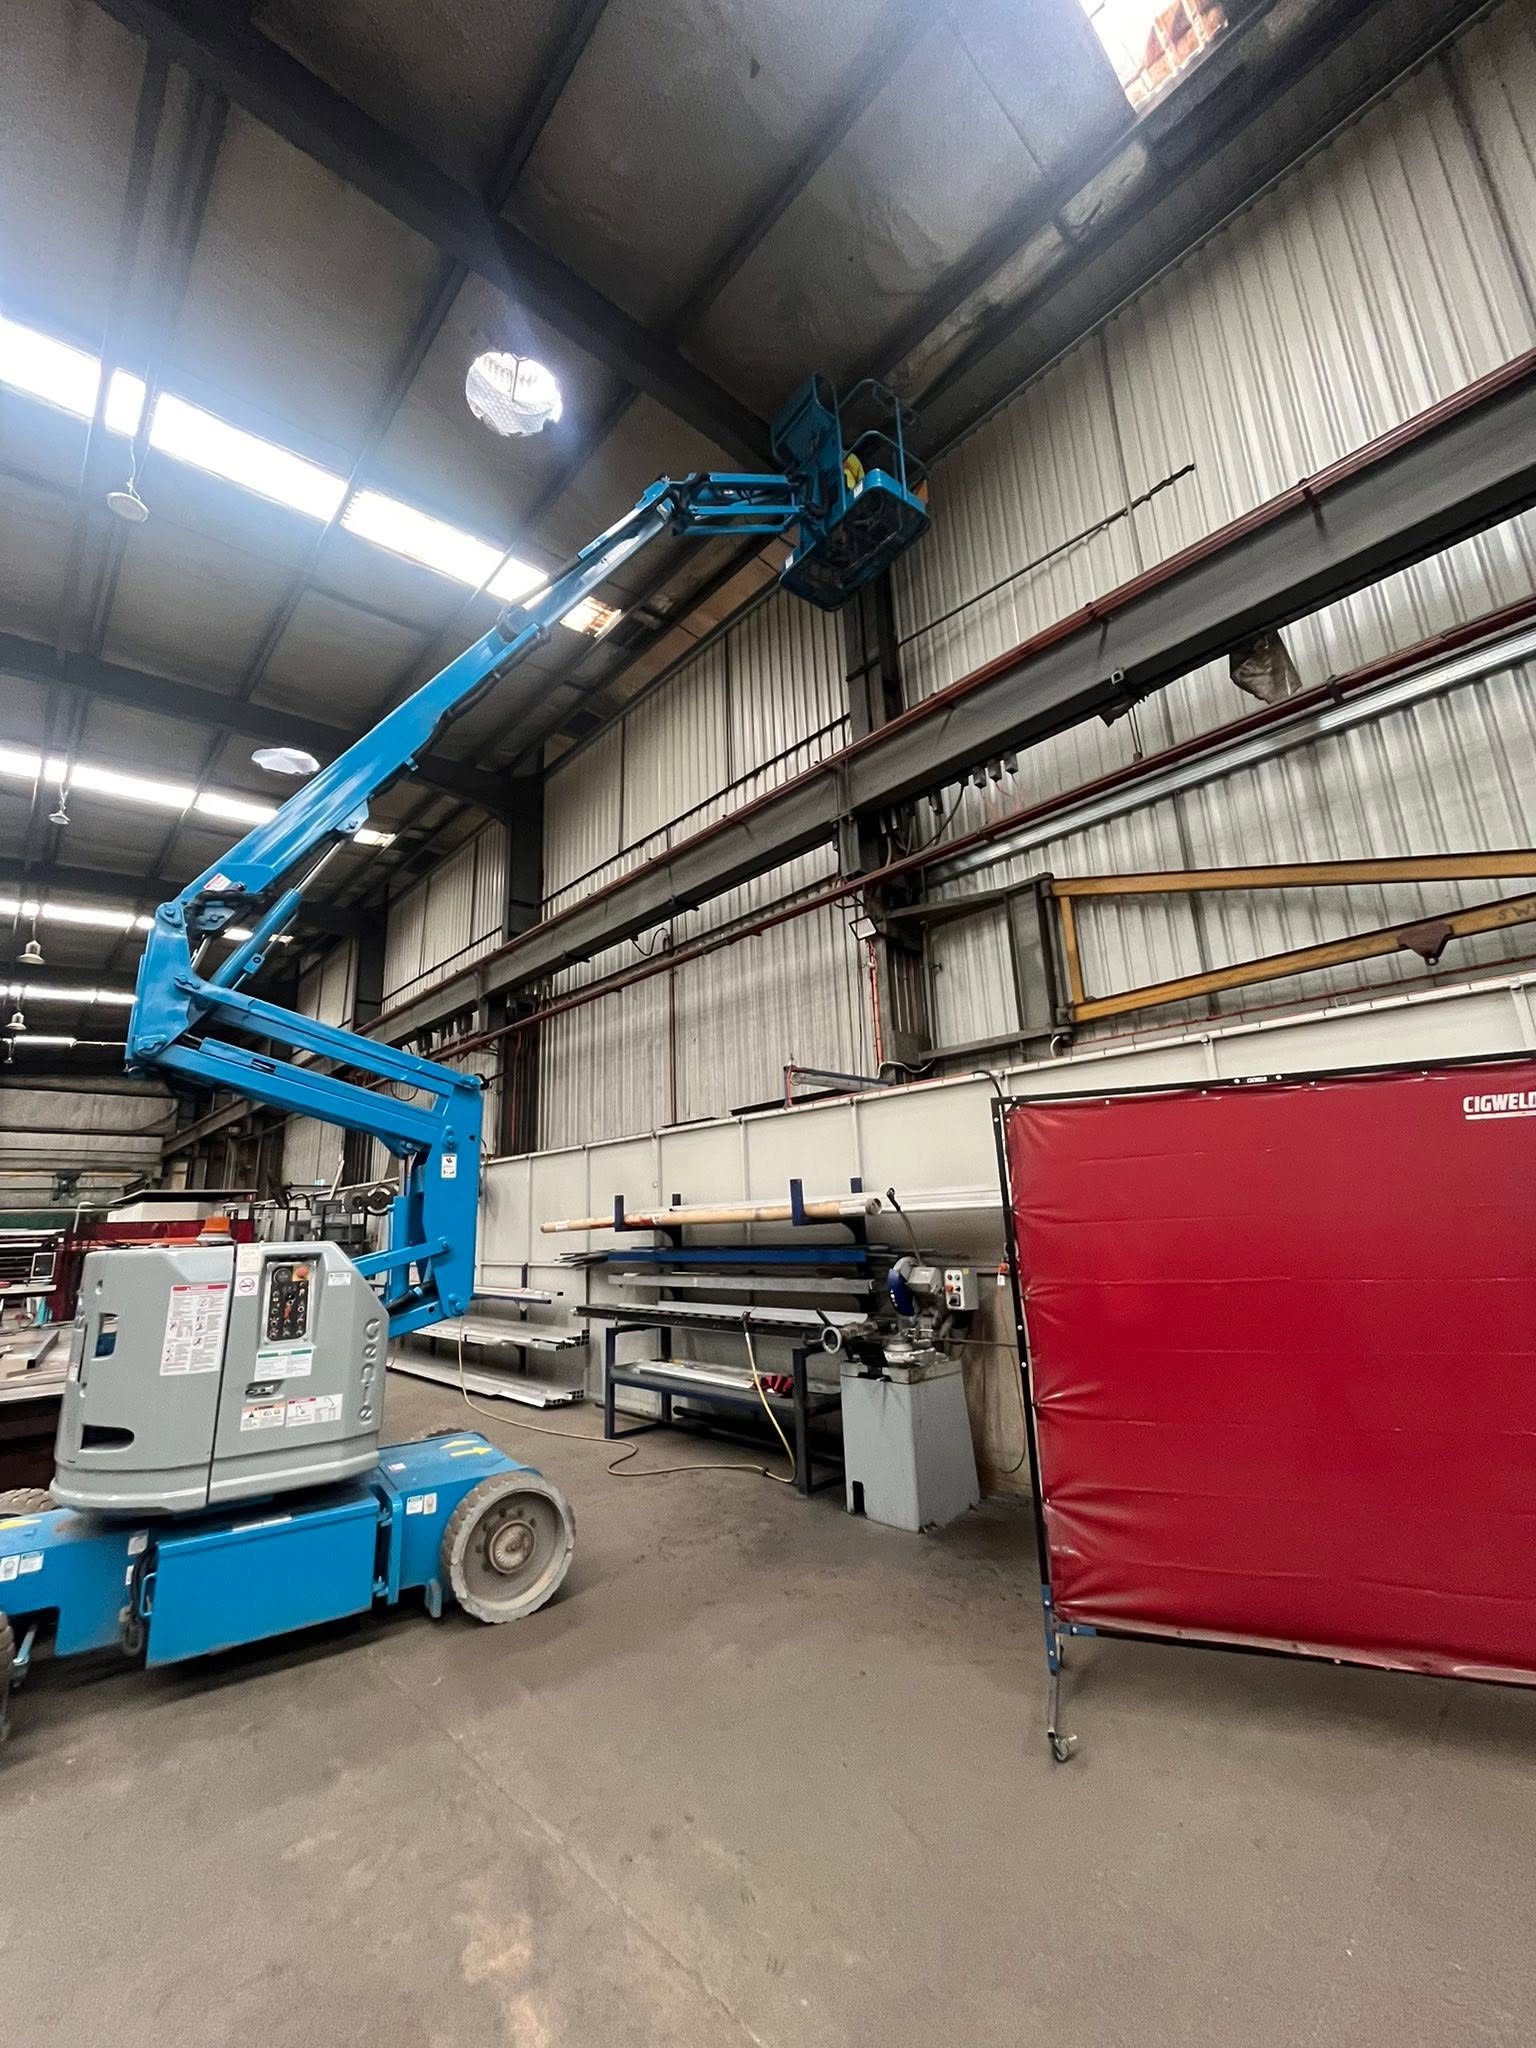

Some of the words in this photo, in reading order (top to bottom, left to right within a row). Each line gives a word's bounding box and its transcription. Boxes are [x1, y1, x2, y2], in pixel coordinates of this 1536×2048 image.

[1498, 902, 1536, 921] SW
[1463, 1091, 1536, 1113] CIGWELD
[359, 1318, 381, 1424] Genie
